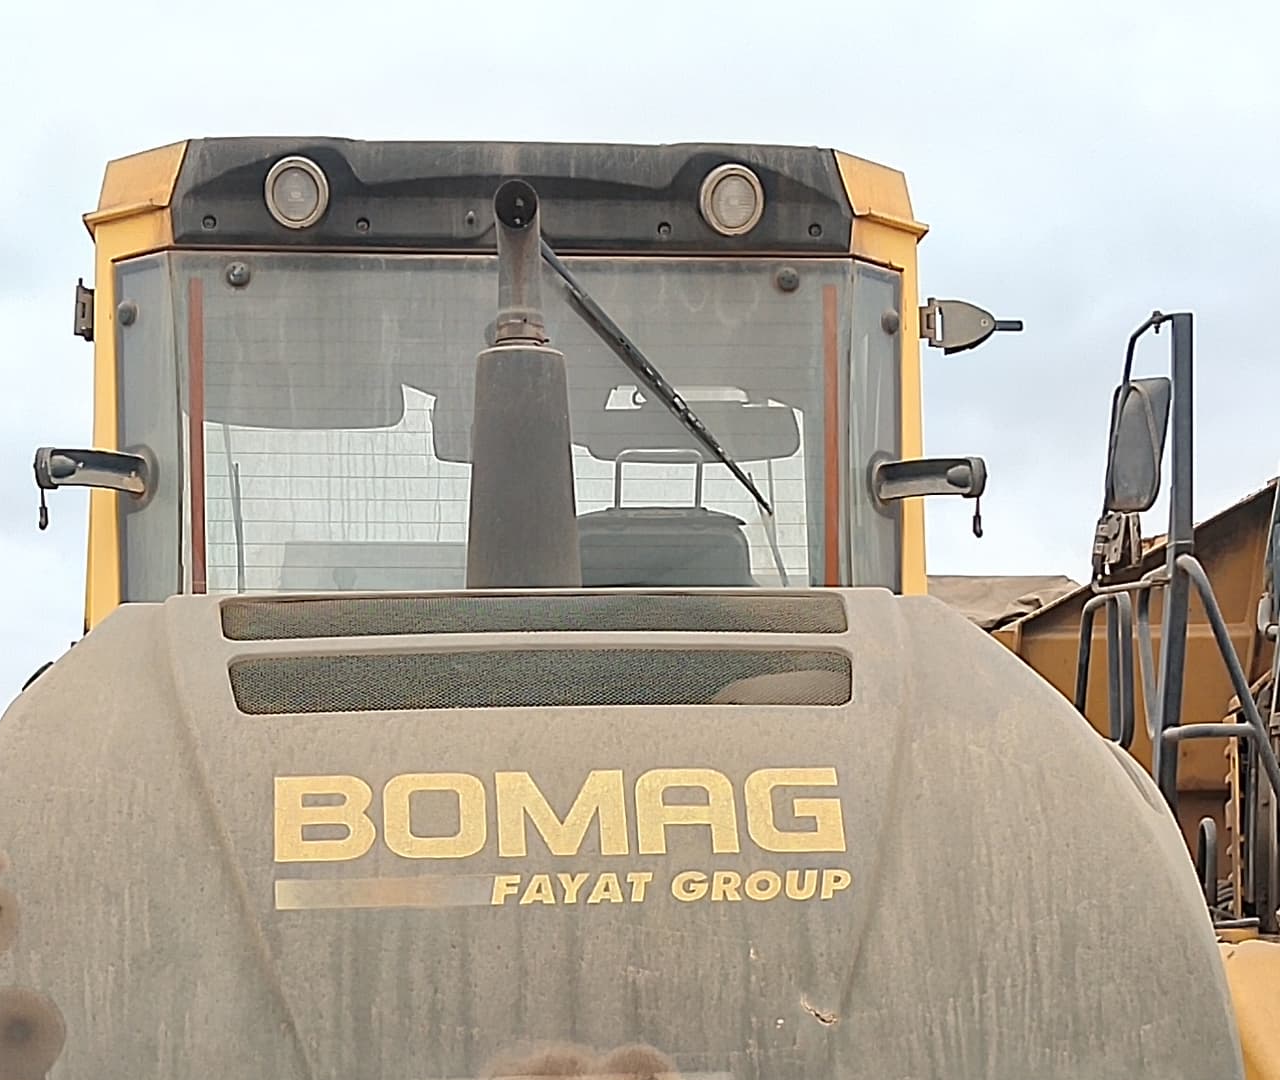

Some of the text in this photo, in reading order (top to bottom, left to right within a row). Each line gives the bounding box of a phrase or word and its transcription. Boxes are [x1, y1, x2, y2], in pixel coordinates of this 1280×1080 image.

[274, 768, 846, 862] BOMAG
[491, 869, 852, 905] FAYAT GROUP
